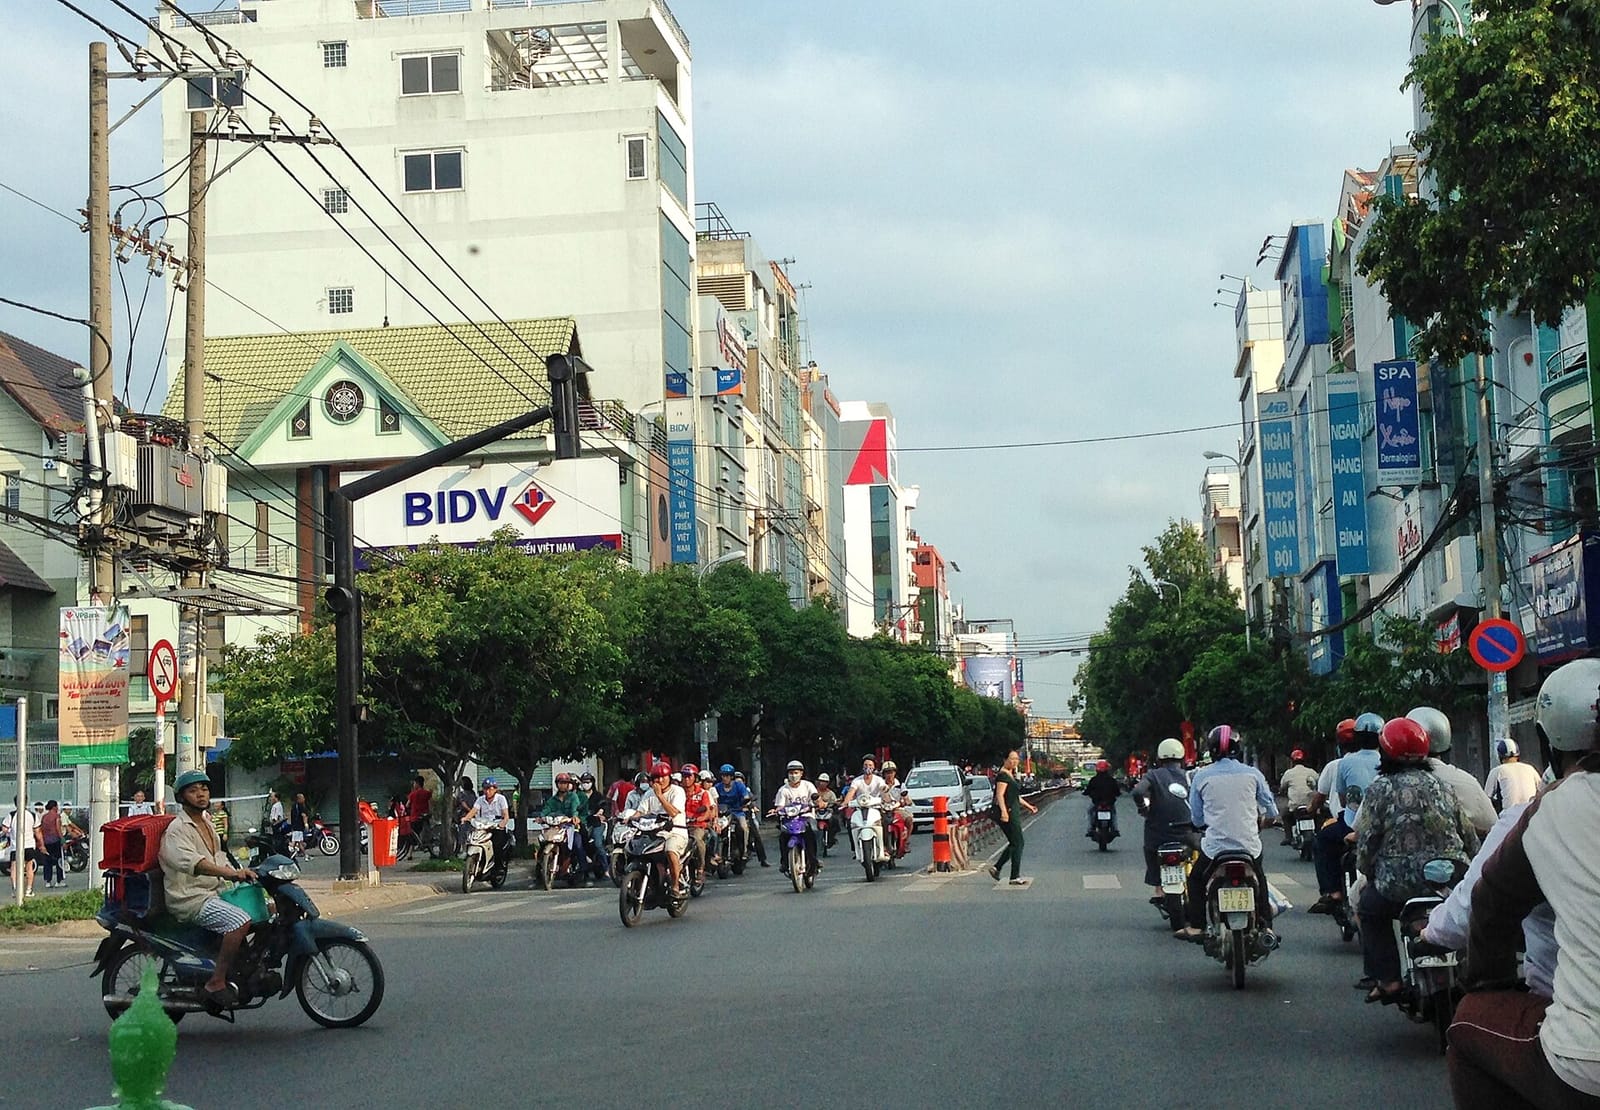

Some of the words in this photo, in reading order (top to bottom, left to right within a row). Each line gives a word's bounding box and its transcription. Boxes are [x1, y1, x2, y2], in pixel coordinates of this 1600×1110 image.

[1379, 367, 1411, 380] SPA
[669, 424, 689, 432] BIDV
[1331, 420, 1361, 440] NGÂN
[1263, 428, 1292, 450] NGÂN
[1264, 458, 1293, 480] HÀNG
[1332, 454, 1361, 474] HÀNG
[405, 486, 508, 526] BIDV
[1265, 490, 1294, 509] TMCP
[1342, 490, 1357, 506] AN
[1268, 515, 1296, 541] QUÂN
[1339, 527, 1364, 546] BÌNH
[556, 542, 576, 553] NAM
[676, 544, 691, 552] NAM
[1274, 545, 1293, 571] ĐỘI
